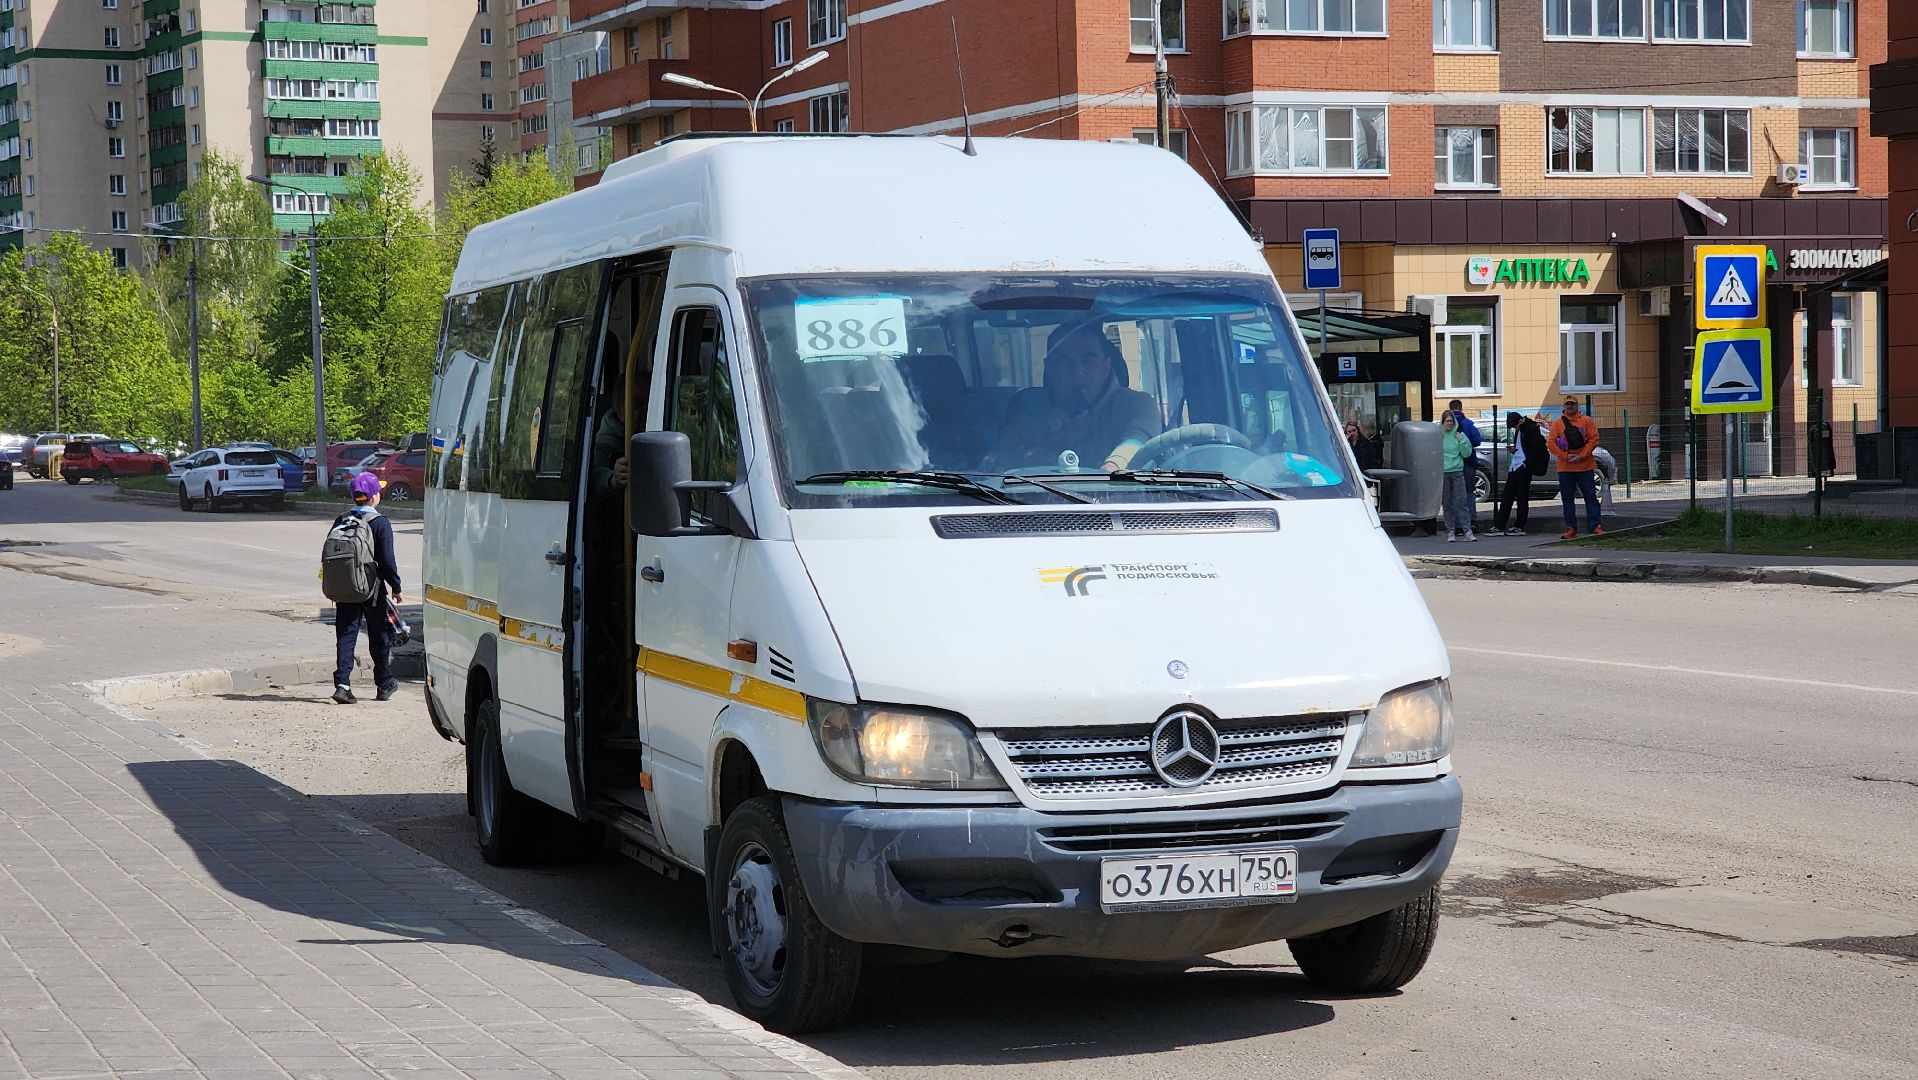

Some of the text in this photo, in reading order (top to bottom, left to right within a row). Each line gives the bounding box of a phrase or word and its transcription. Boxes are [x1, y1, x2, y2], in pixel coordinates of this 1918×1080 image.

[1495, 258, 1591, 282] АПТЕКА
[1790, 249, 1882, 269] ЗООМАГАЗИН
[807, 317, 898, 351] 886
[1114, 564, 1188, 572] ТРАНСПОРТ
[1112, 856, 1288, 897] О376ХН 750
[1253, 881, 1277, 892] RUS
